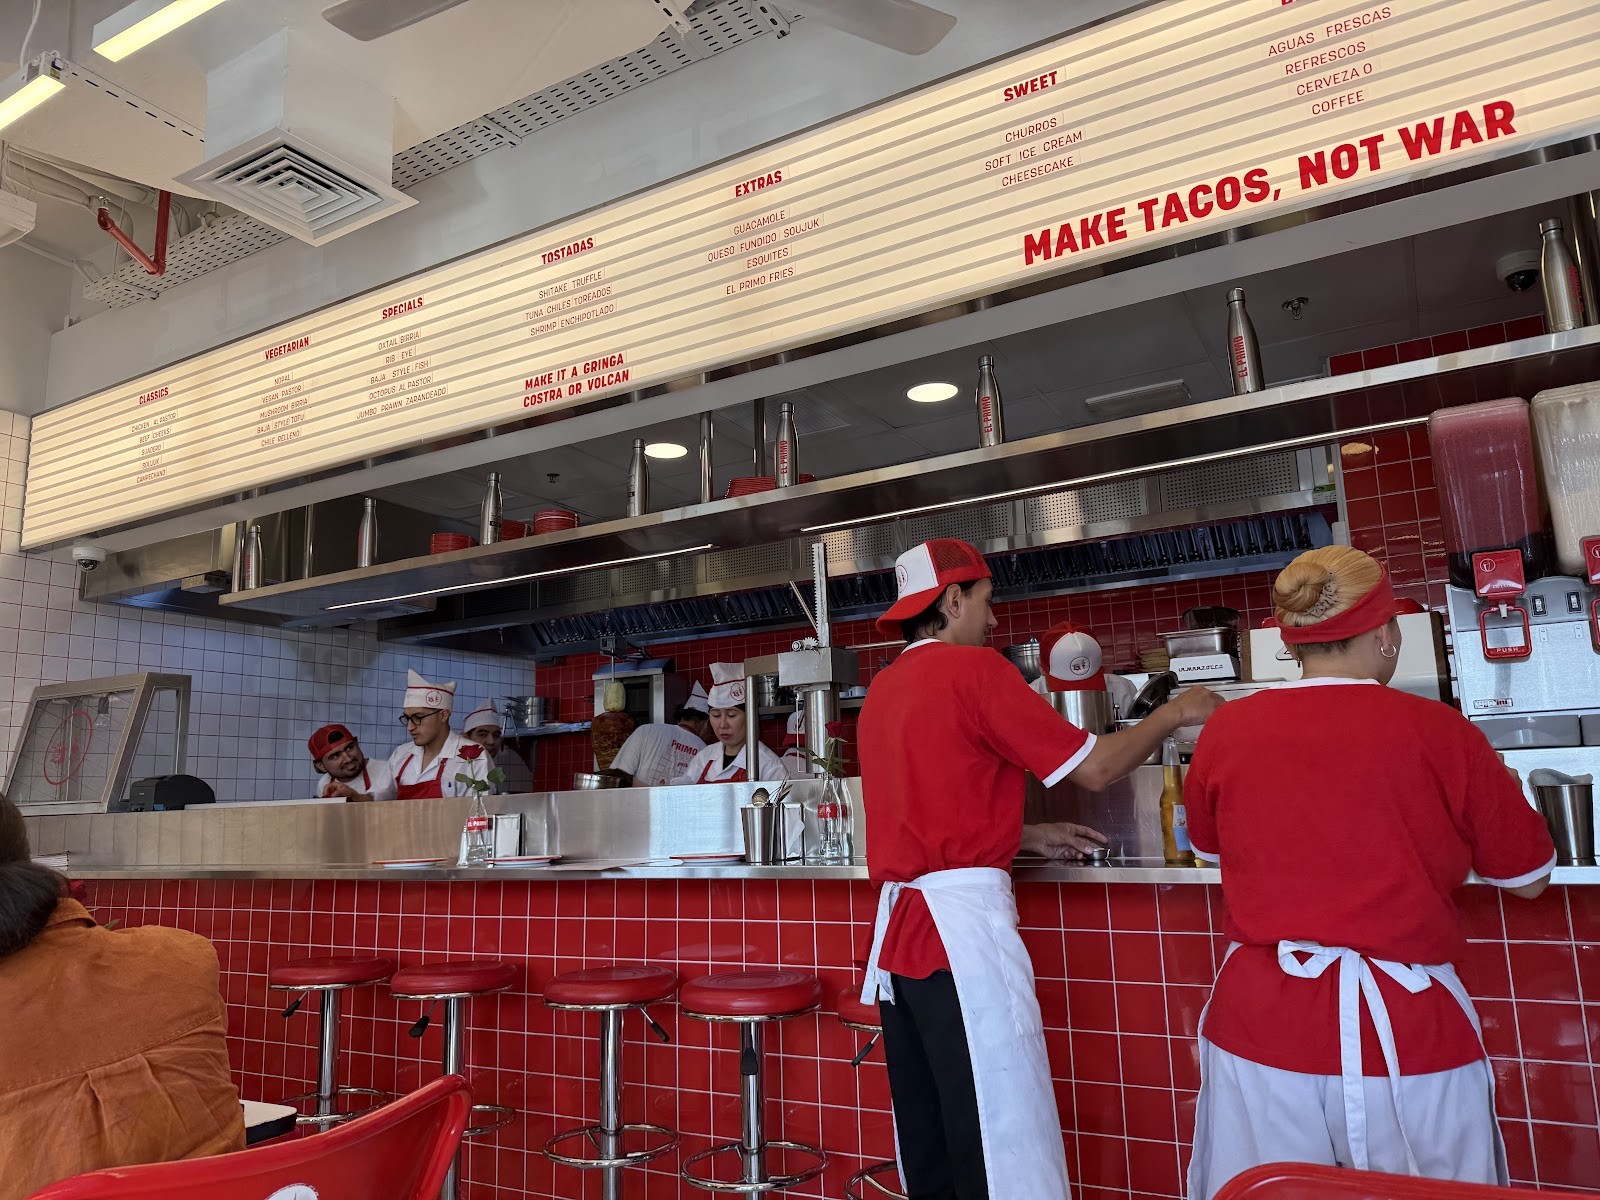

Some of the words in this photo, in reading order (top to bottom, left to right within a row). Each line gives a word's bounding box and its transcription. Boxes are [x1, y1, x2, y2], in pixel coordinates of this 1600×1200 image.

[1268, 32, 1315, 57] AGUAS
[1326, 6, 1392, 38] FRESCAS
[1285, 41, 1366, 75] REFRESCOS
[1003, 70, 1058, 102] SWEET
[1296, 67, 1360, 96] CERVEZA
[1363, 62, 1373, 75] O
[1311, 90, 1365, 115] COFFEE
[1005, 117, 1057, 143] CHURROS
[985, 154, 1012, 171] SOFT
[1019, 146, 1037, 161] ICE
[1043, 130, 1083, 152] CREAM
[735, 170, 782, 198] EXTRAS
[1001, 156, 1074, 187] CHEESECAKE
[1023, 207, 1128, 266] MAKE
[1137, 167, 1282, 233] TACOS,
[1297, 133, 1384, 190] NOT
[1396, 100, 1517, 162] WAR
[733, 210, 786, 236] GUACAMOLE
[541, 237, 594, 265] TOSTADAS
[707, 245, 735, 263] QUESO
[740, 232, 777, 253] FUNDIDO
[783, 217, 820, 239] SOUJUK
[746, 247, 789, 269] ESQUITES
[538, 282, 568, 299] SHITAKE
[572, 270, 602, 289] TRUFFLE
[726, 284, 736, 295] EL
[739, 275, 766, 291] PRIMO
[769, 266, 794, 282] FRIES
[382, 296, 423, 320] SPECIALS
[525, 308, 544, 321] TUNA
[546, 299, 571, 314] CHILES
[574, 286, 611, 306] TOREADOS
[530, 321, 557, 337] SHRIMP
[560, 303, 614, 328] ENCHIPOTLADO
[264, 336, 309, 360] VEGETARIAN
[378, 337, 398, 351] OXTAIL
[400, 331, 420, 344] BIRRIA
[1232, 335, 1248, 367] PRIMO
[385, 354, 396, 364] RIB
[401, 348, 413, 360] EYE
[274, 374, 291, 386] NOPAL
[370, 373, 386, 385] BAJA
[392, 365, 411, 378] STYLE
[414, 360, 429, 371] FISH
[525, 372, 553, 391] MAKE
[556, 368, 567, 382] IT
[570, 366, 578, 378] A
[583, 353, 624, 374] GRINGA
[1238, 367, 1248, 379] EL
[139, 386, 169, 405] CLASSICS
[262, 392, 279, 404] VEGAN
[281, 384, 302, 398] PASTOR
[368, 385, 396, 400] OCTOPUS
[398, 384, 406, 392] AL
[407, 375, 431, 390] PASTOR
[523, 387, 563, 408] COSTRA
[568, 382, 582, 396] OR
[587, 369, 629, 391] VOLCAN
[259, 403, 289, 419] MUSHROOM
[290, 397, 308, 409] BIRRIA
[356, 407, 377, 420] JUMBO
[380, 400, 403, 413] PRAWN
[405, 387, 446, 406] ZARANDEADO
[981, 395, 992, 422] PRIMO
[273, 419, 290, 430] STYLE
[291, 413, 305, 424] TOFU
[983, 423, 993, 434] EL
[260, 436, 275, 448] CHILE
[277, 429, 300, 443] RELLENO
[671, 739, 698, 756] PRIMO
